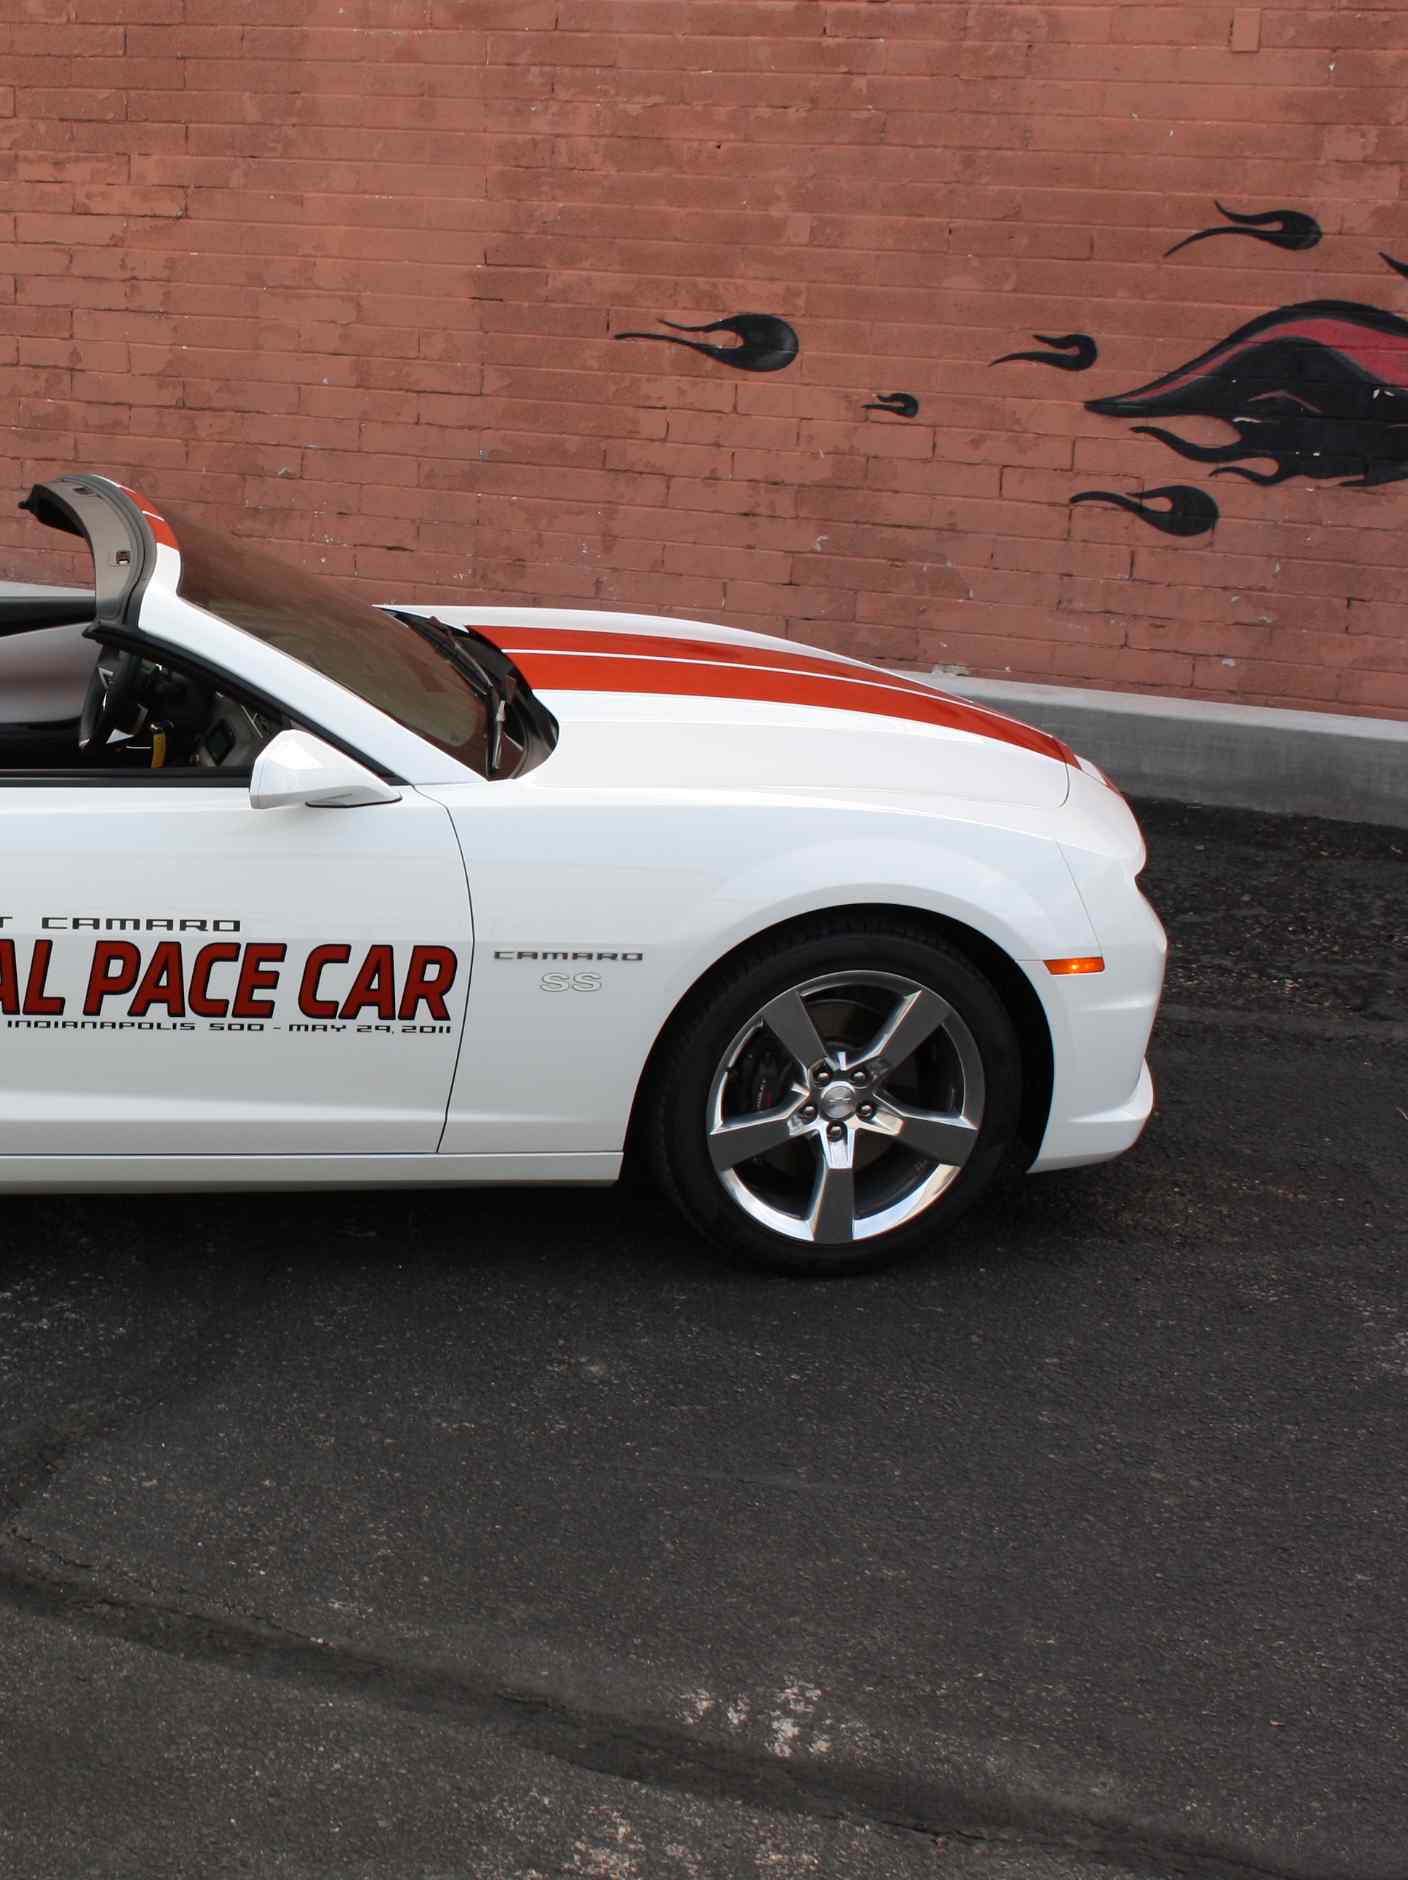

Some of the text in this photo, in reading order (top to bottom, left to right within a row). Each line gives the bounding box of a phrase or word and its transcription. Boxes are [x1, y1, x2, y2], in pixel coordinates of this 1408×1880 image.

[41, 916, 241, 932] CAMARO
[494, 951, 643, 961] CAMARO
[82, 939, 287, 1018] PACE
[298, 943, 458, 1020] CAR
[540, 971, 602, 992] SS
[7, 1020, 196, 1031] INDIANAPOLIS
[209, 1022, 264, 1032] 500
[288, 1023, 347, 1032] MAY
[401, 1024, 451, 1034] 2011
